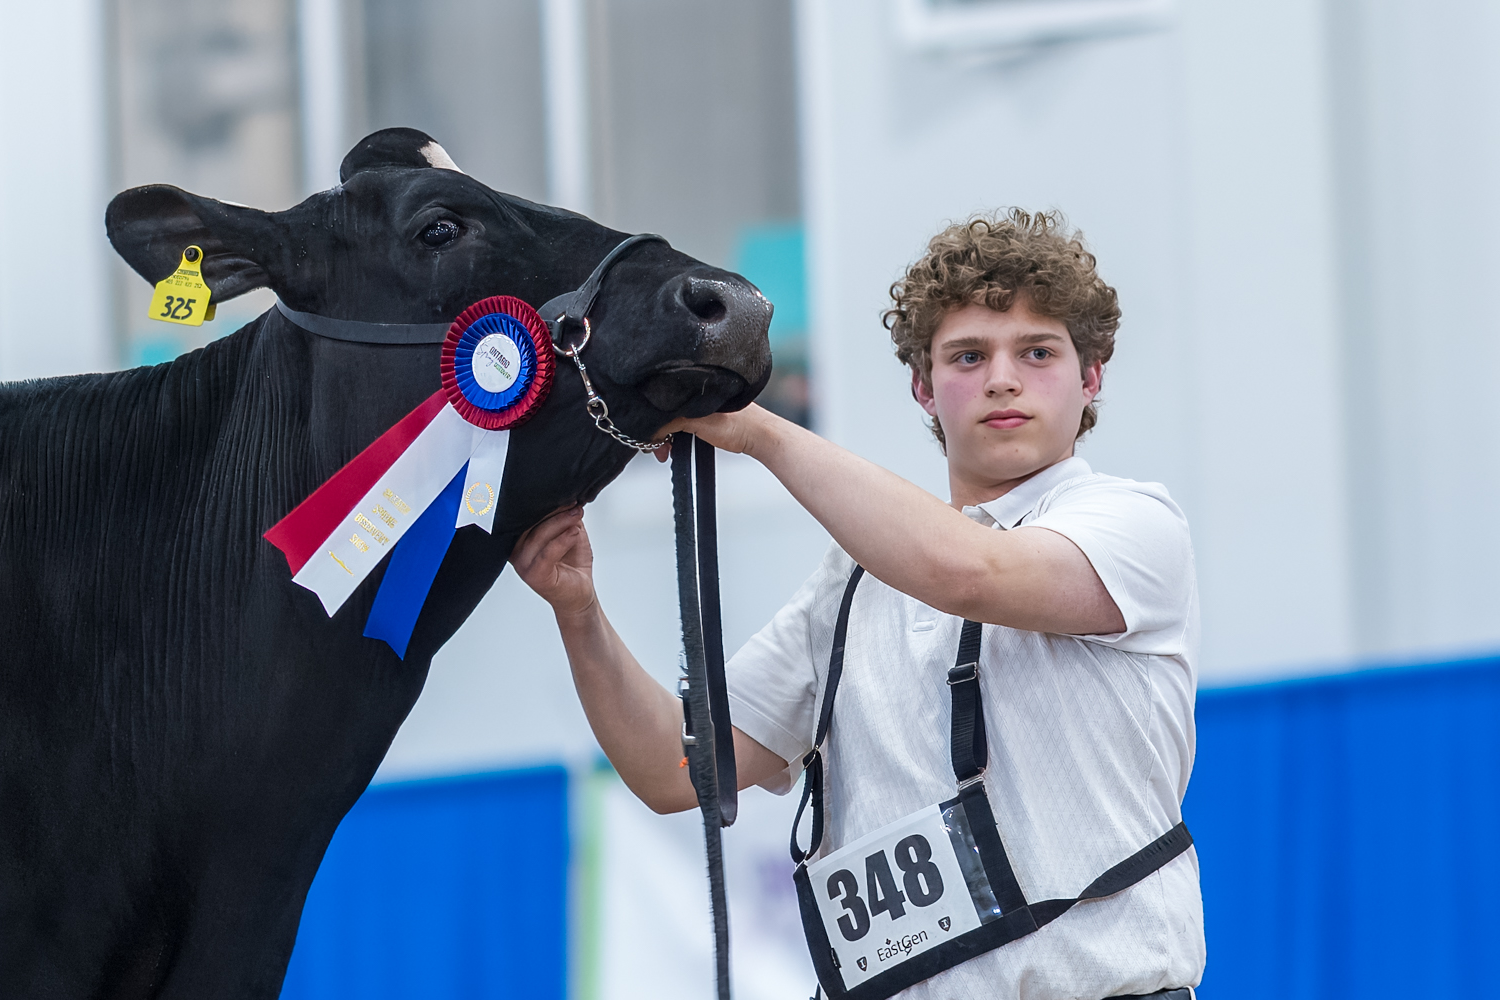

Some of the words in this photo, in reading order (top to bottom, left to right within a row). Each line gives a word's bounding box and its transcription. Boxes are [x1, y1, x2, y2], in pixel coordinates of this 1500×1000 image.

[160, 295, 197, 320] 325
[489, 346, 511, 369] ONTARIO
[826, 834, 945, 942] 348
[876, 930, 929, 962] EastGen
